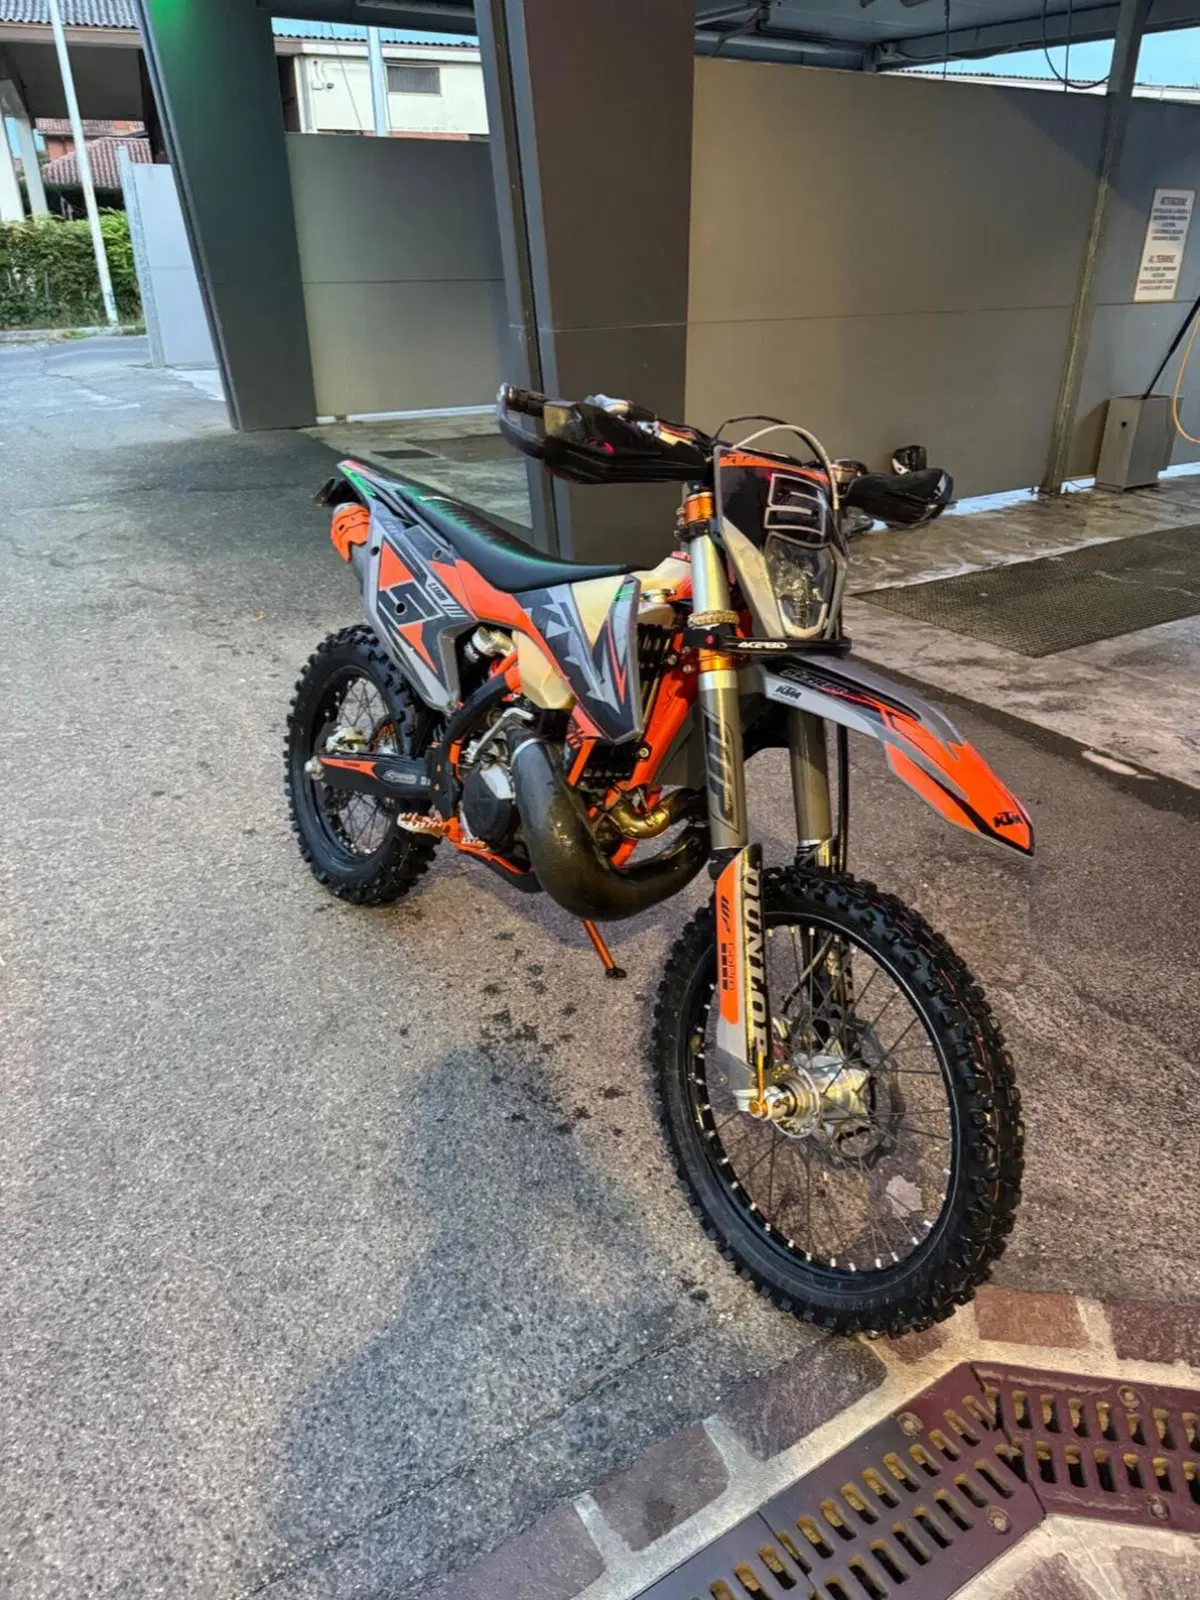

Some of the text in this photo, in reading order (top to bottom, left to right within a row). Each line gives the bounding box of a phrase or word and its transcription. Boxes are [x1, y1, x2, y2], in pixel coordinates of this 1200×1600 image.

[775, 685, 802, 700] KTM
[993, 811, 1024, 828] KTM
[744, 866, 767, 1057] DUNLOP
